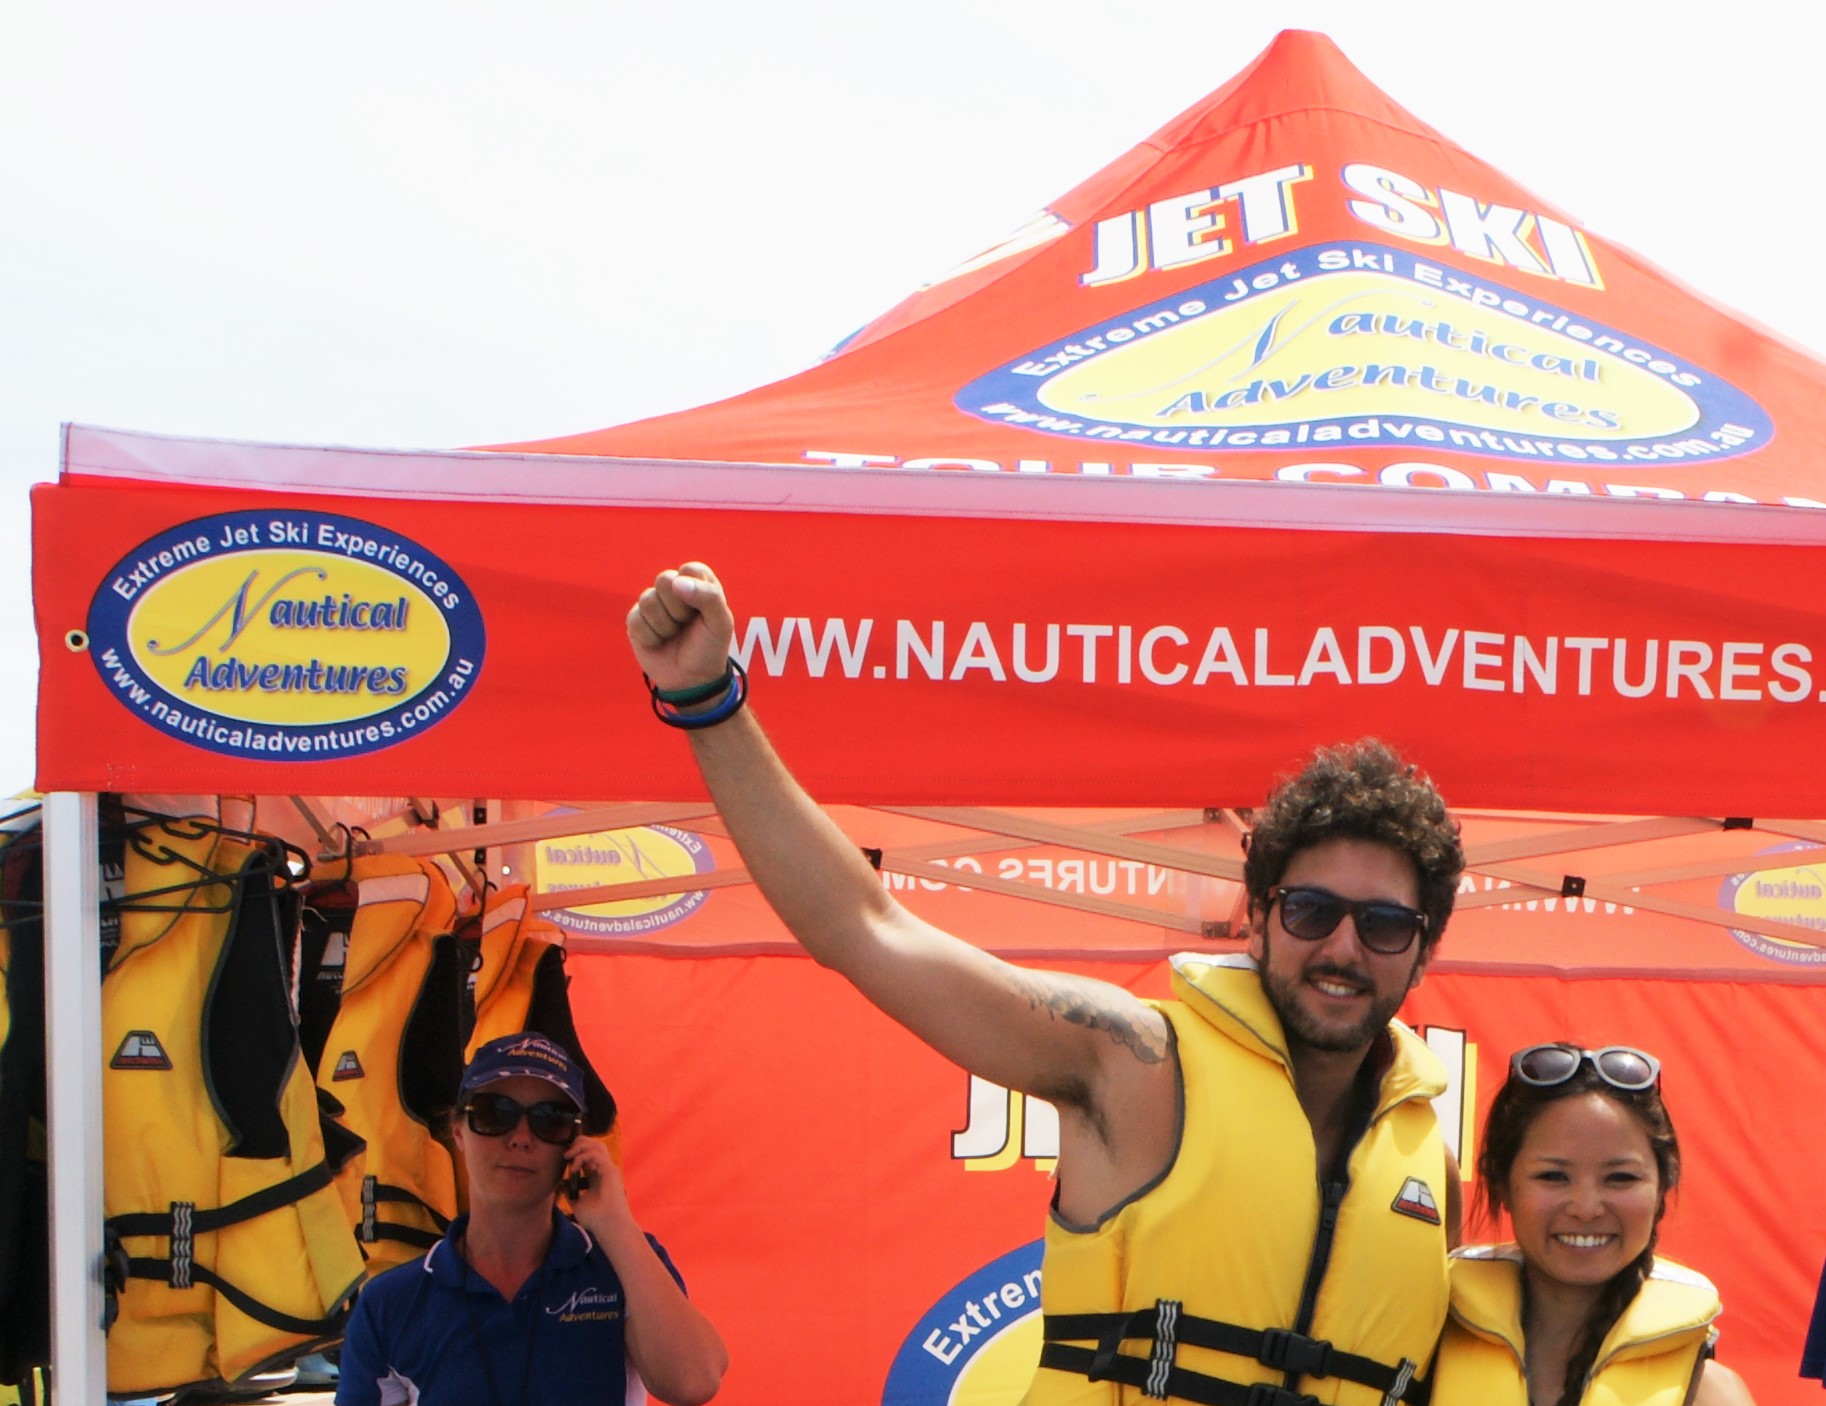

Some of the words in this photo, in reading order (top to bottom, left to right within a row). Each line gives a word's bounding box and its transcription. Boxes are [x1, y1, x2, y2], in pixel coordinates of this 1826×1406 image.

[1080, 162, 1314, 286] JET
[1340, 162, 1606, 291] SKI
[1011, 299, 1207, 378] Extreme
[1224, 261, 1302, 301] Jet
[1318, 249, 1394, 271] Ski
[1414, 262, 1702, 387] Experiences
[1080, 288, 1602, 401] Nautical
[980, 402, 1756, 462] www.nauticaladventures.com.au
[1155, 361, 1622, 431] Adventures
[113, 533, 211, 601] Extreme
[220, 523, 260, 548] Jet
[269, 521, 309, 544] Ski
[318, 524, 460, 610] Experiences
[147, 567, 410, 655] Nautical
[101, 648, 475, 752] www.nauticaladventures.com.au
[184, 655, 408, 694] Adventures
[546, 1287, 618, 1314] Nautical
